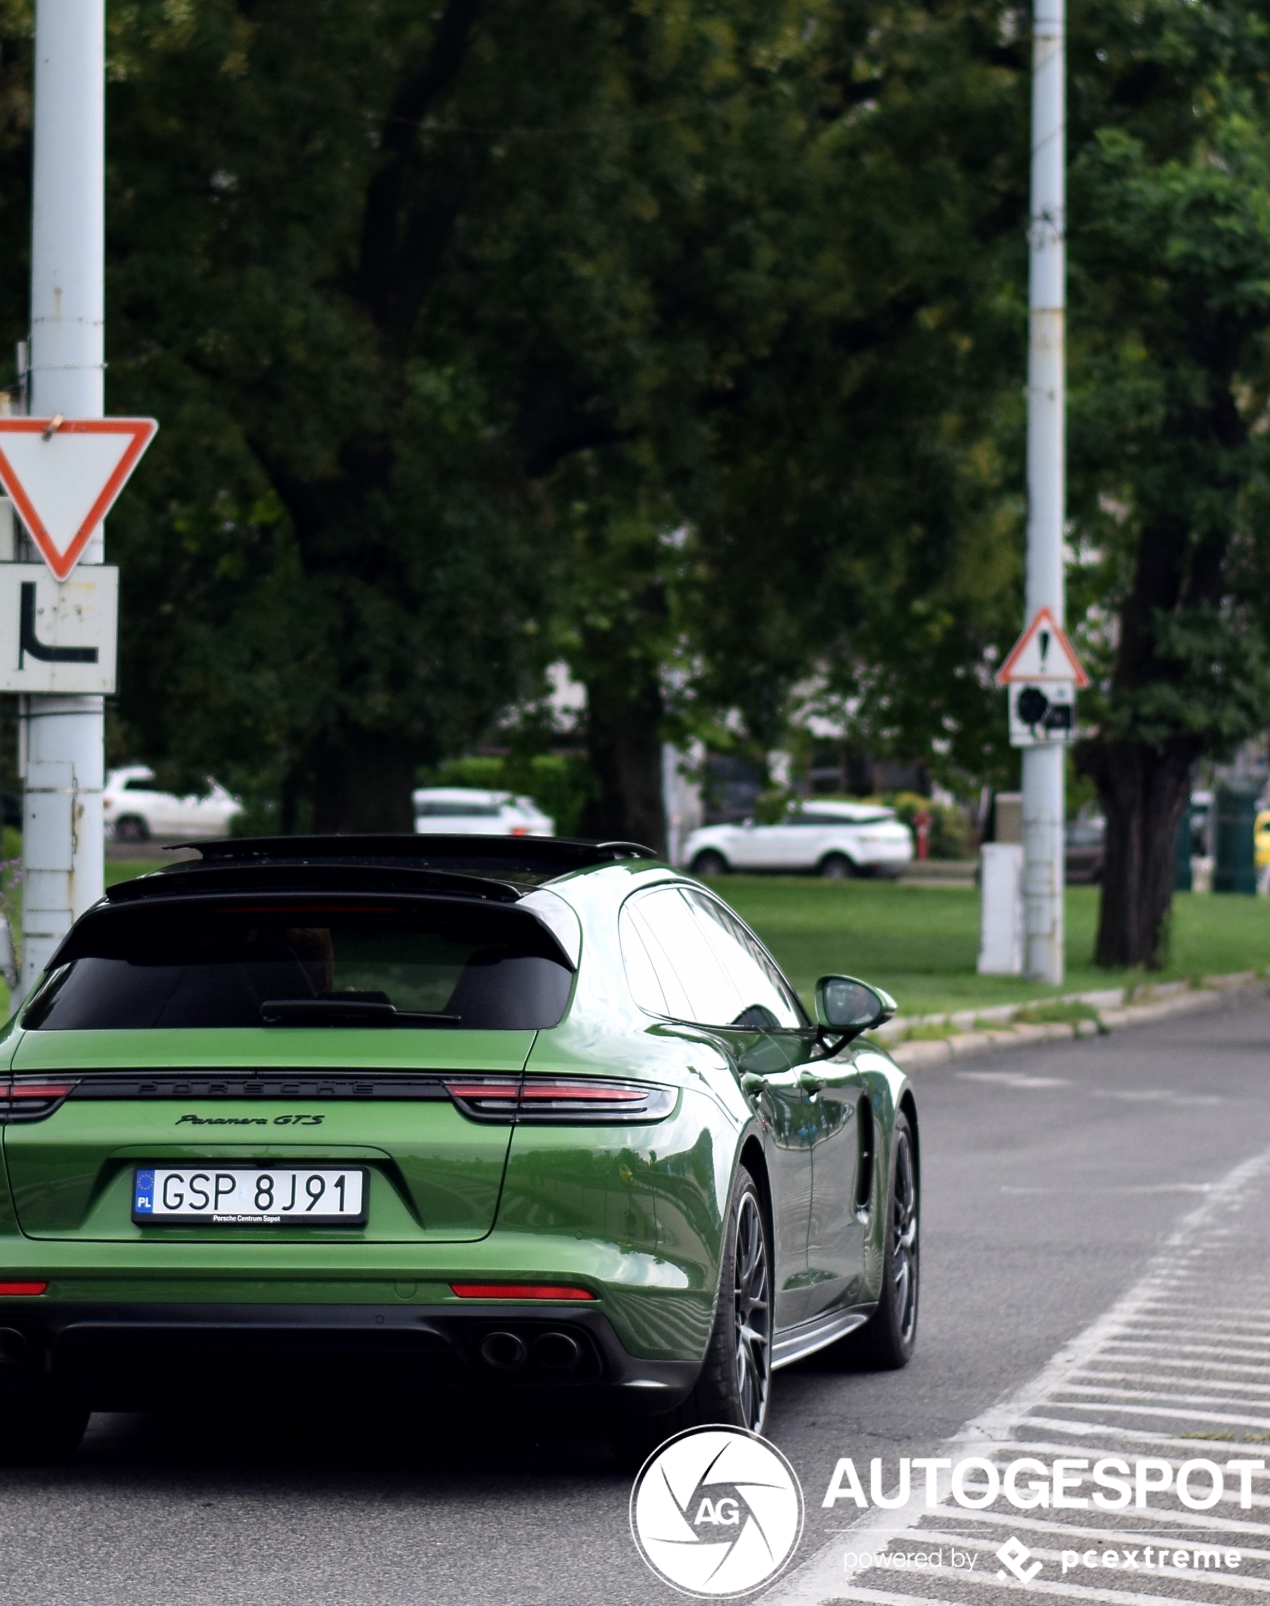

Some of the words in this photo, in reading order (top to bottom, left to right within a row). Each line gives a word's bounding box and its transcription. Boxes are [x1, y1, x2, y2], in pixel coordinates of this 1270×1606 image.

[137, 1081, 375, 1095] PORSCHE
[175, 1114, 268, 1126] Panamera
[273, 1114, 326, 1126] GTS
[162, 1173, 237, 1211] GSP
[253, 1174, 347, 1212] 8J91
[137, 1197, 152, 1209] PL
[213, 1214, 237, 1222] Porsche
[237, 1214, 263, 1222] Centrum
